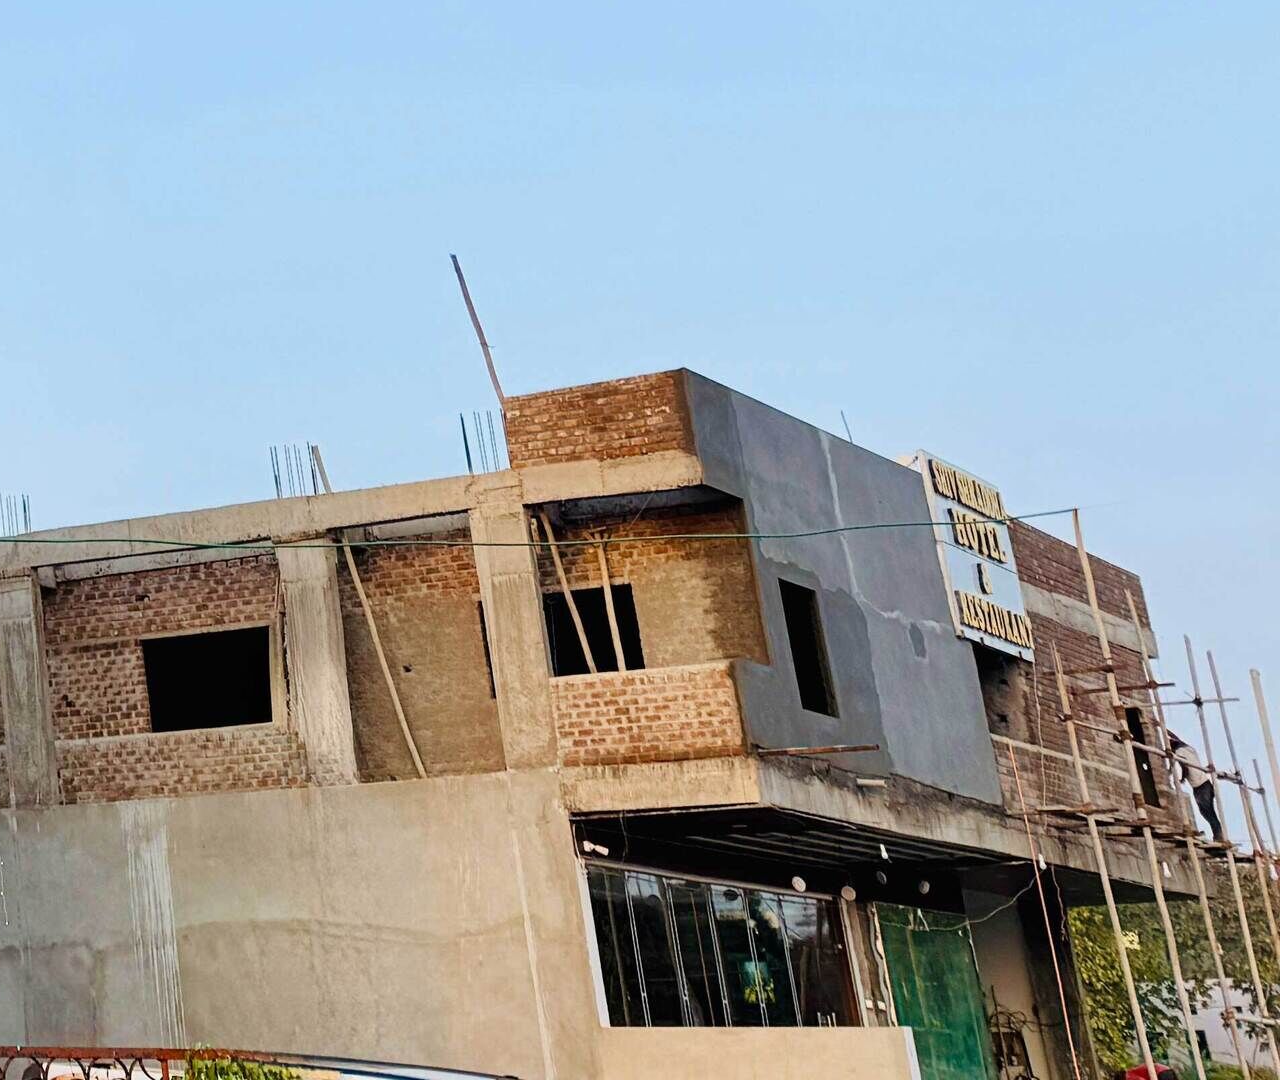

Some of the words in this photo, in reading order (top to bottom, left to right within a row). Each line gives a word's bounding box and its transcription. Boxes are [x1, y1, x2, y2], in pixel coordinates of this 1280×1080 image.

[930, 460, 956, 500] SHIV
[951, 508, 1008, 563] HOTEL
[958, 592, 1035, 650] RESTAURANT
